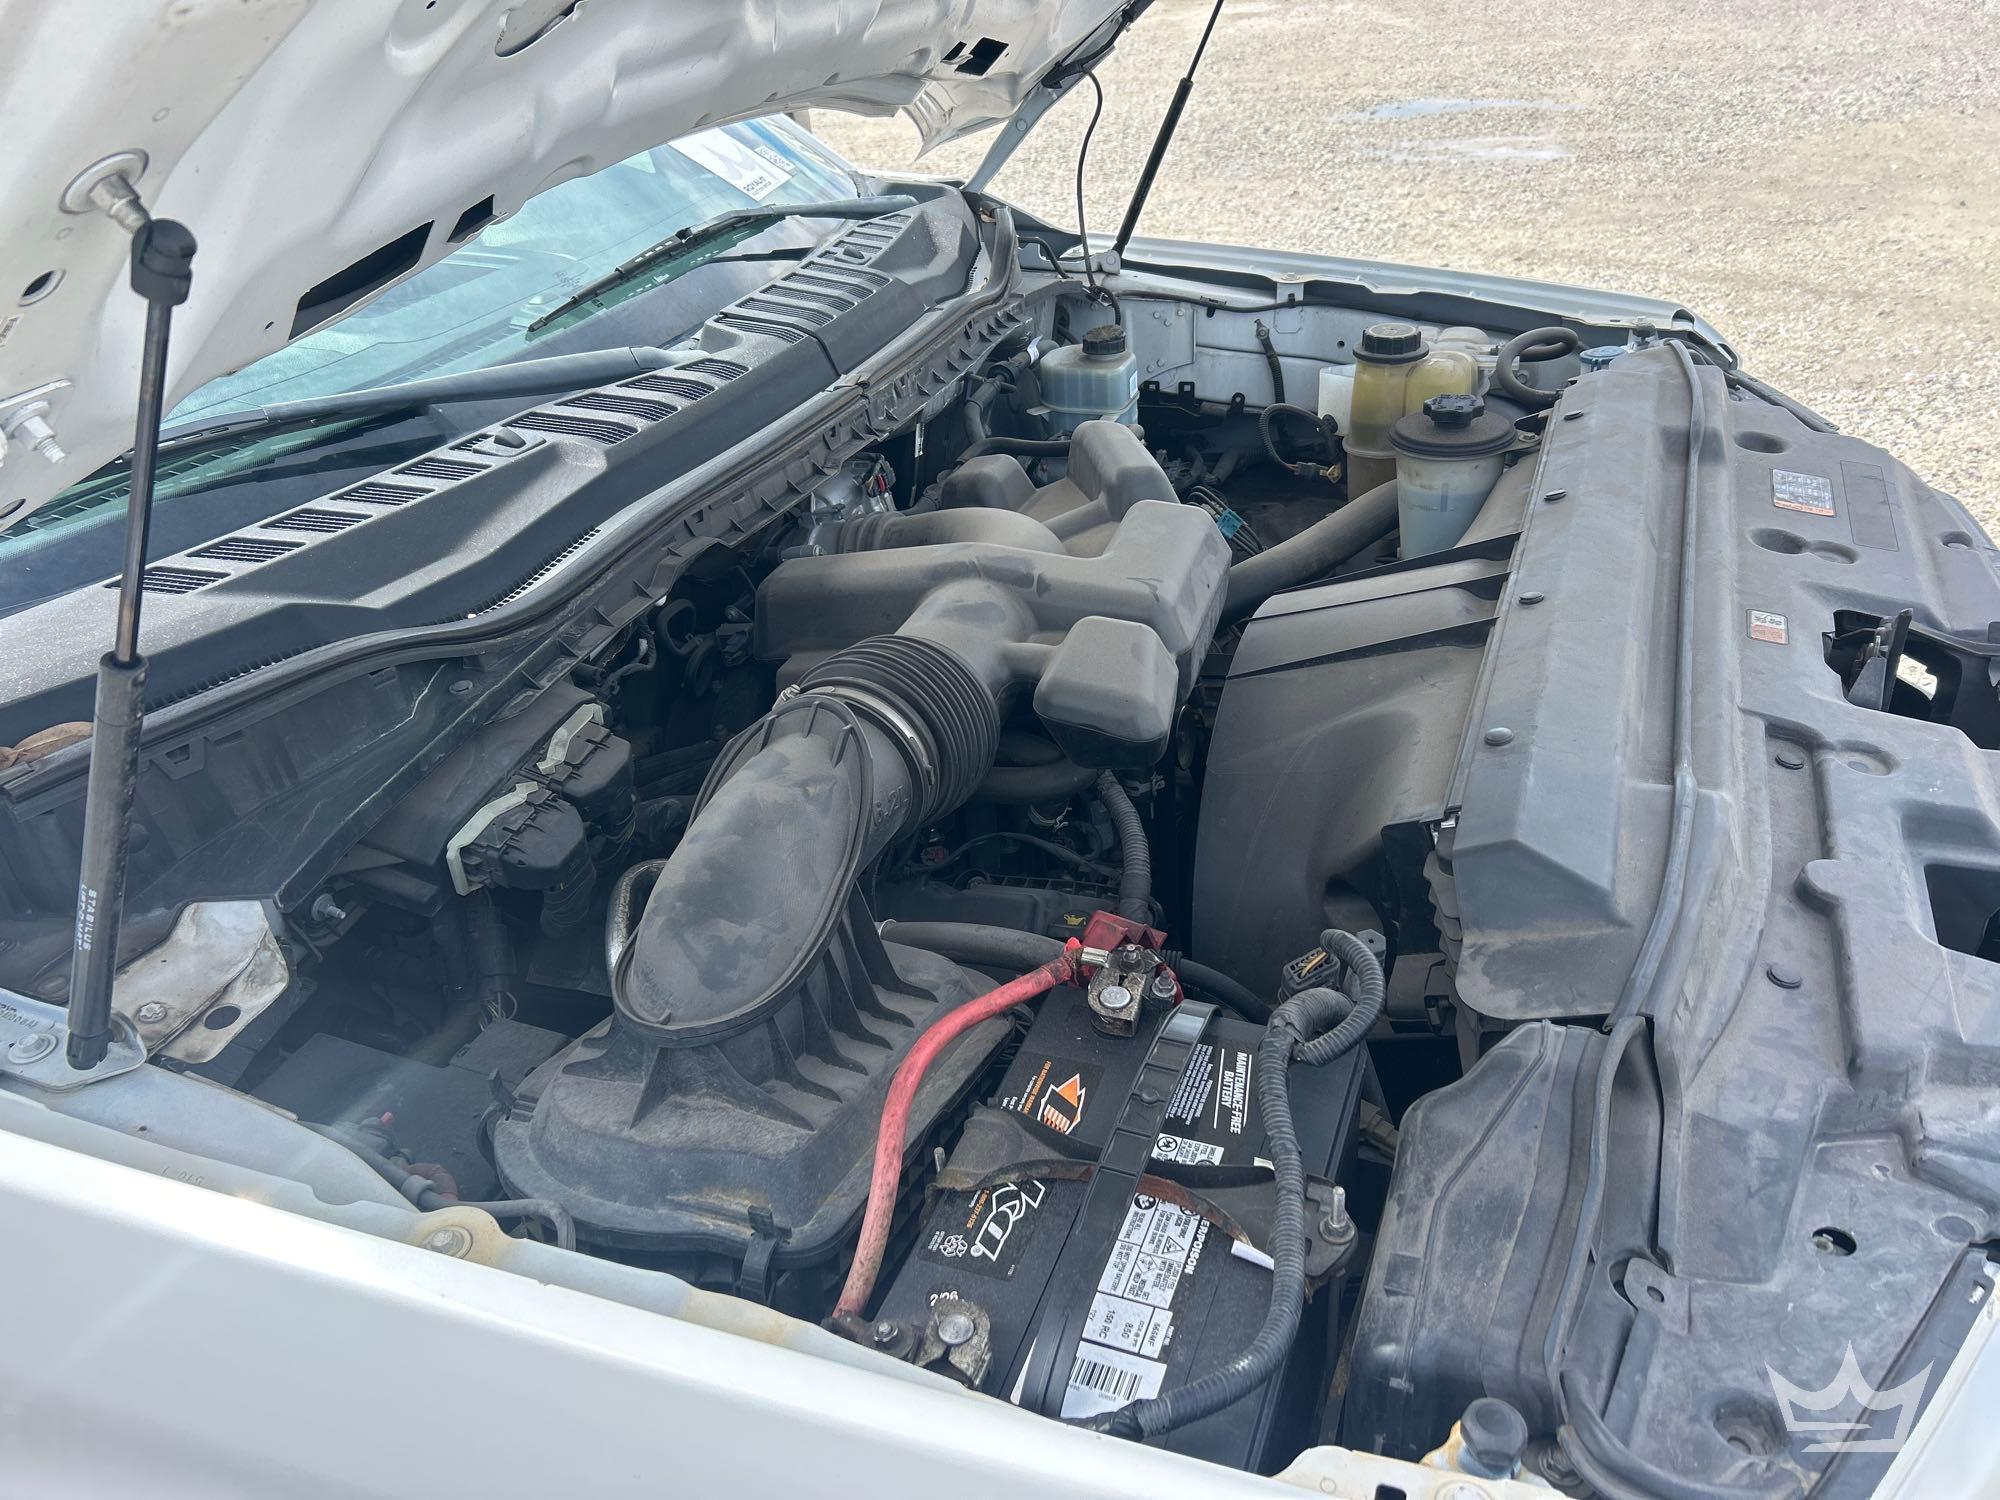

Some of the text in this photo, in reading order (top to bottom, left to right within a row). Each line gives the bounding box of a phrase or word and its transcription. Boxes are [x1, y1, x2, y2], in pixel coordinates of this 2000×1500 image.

[82, 888, 98, 951] STABILUS
[1022, 1094, 1036, 1115] WARRAN
[1220, 1069, 1233, 1108] BATTERY
[1229, 1051, 1247, 1134] MAINTENANCE-FREE
[1184, 1217, 1210, 1275] ER/POISON
[1098, 1309, 1116, 1339] 150 RC
[1121, 1322, 1134, 1339] 850
